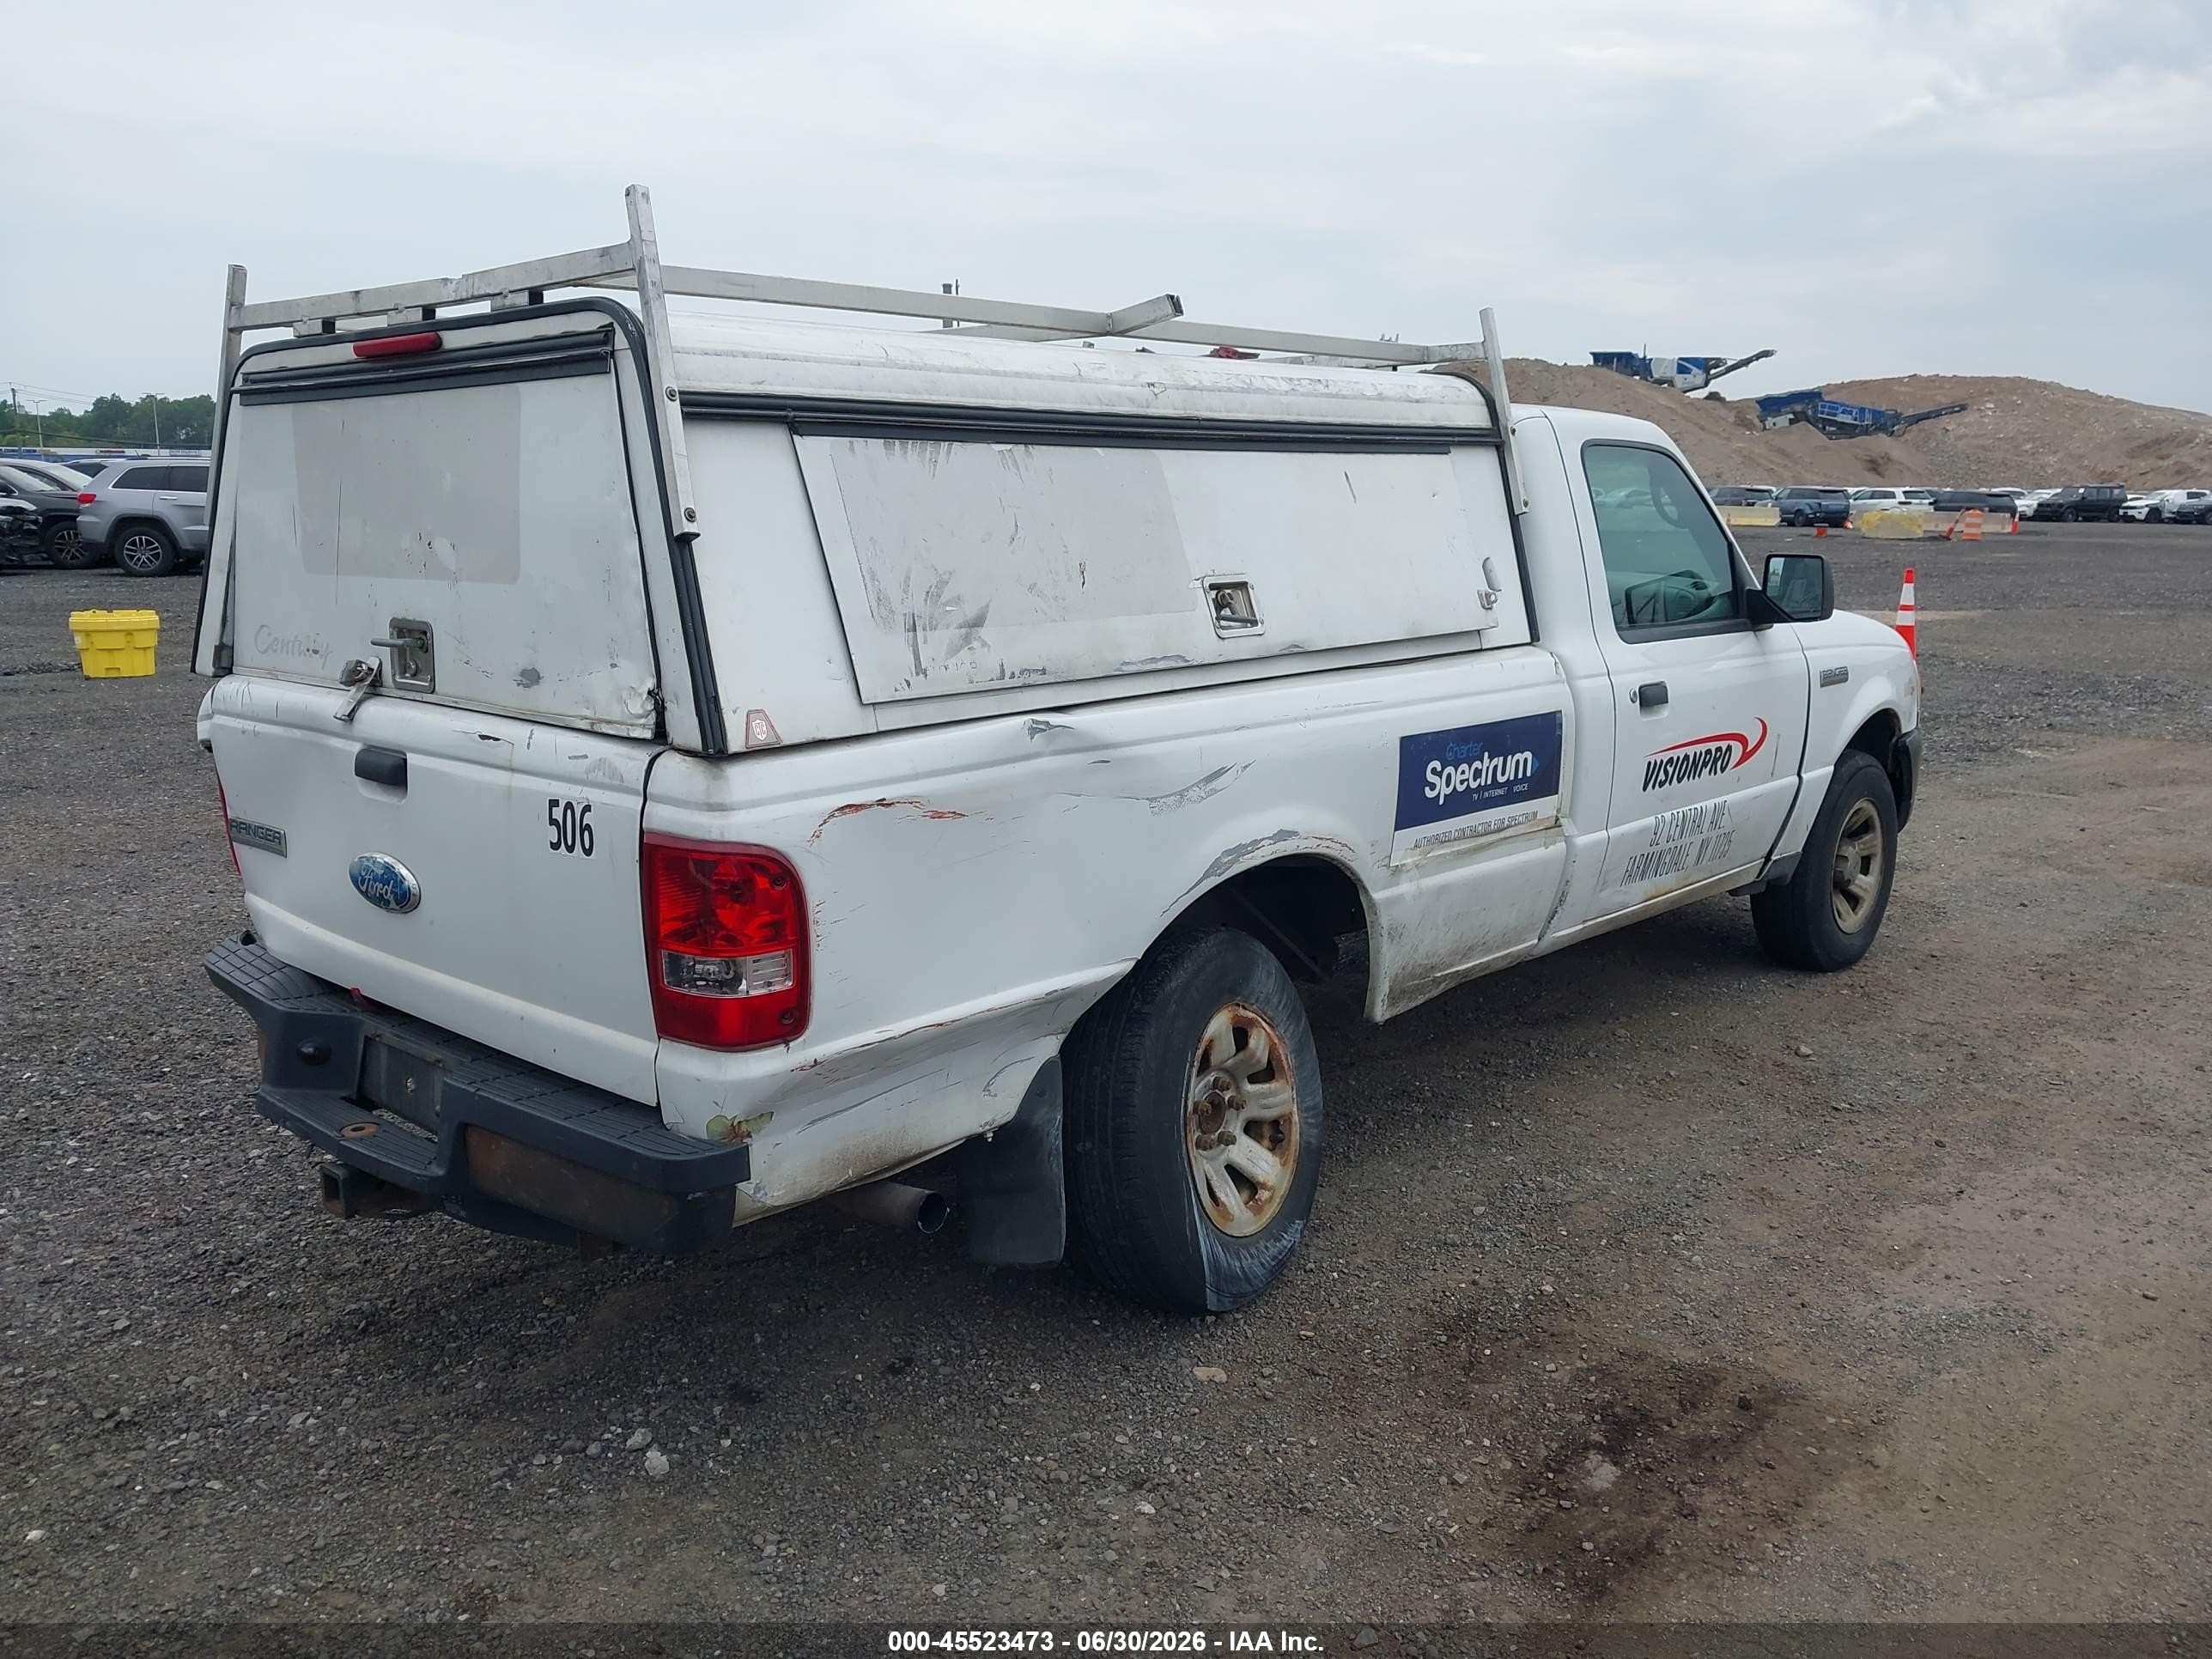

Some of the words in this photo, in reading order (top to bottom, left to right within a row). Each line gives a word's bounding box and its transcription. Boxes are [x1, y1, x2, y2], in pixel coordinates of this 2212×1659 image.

[1445, 742, 1483, 760] Charter
[1642, 743, 1733, 793] VISIONPRO
[1425, 750, 1532, 805] Spectrum
[1483, 787, 1509, 799] INTERNET
[1513, 783, 1529, 793] VOICE
[229, 819, 282, 845] RANGER
[547, 798, 594, 857] 506
[1413, 830, 1452, 849] AUTHORIZED
[1453, 820, 1492, 841] CONTRACTOR
[1492, 817, 1505, 830] FOR
[1506, 810, 1539, 827] SPECTRUM
[1649, 815, 1667, 848] 92
[1666, 804, 1707, 843] CENTRAL
[1694, 836, 1713, 866] NY
[358, 861, 393, 900] Ford
